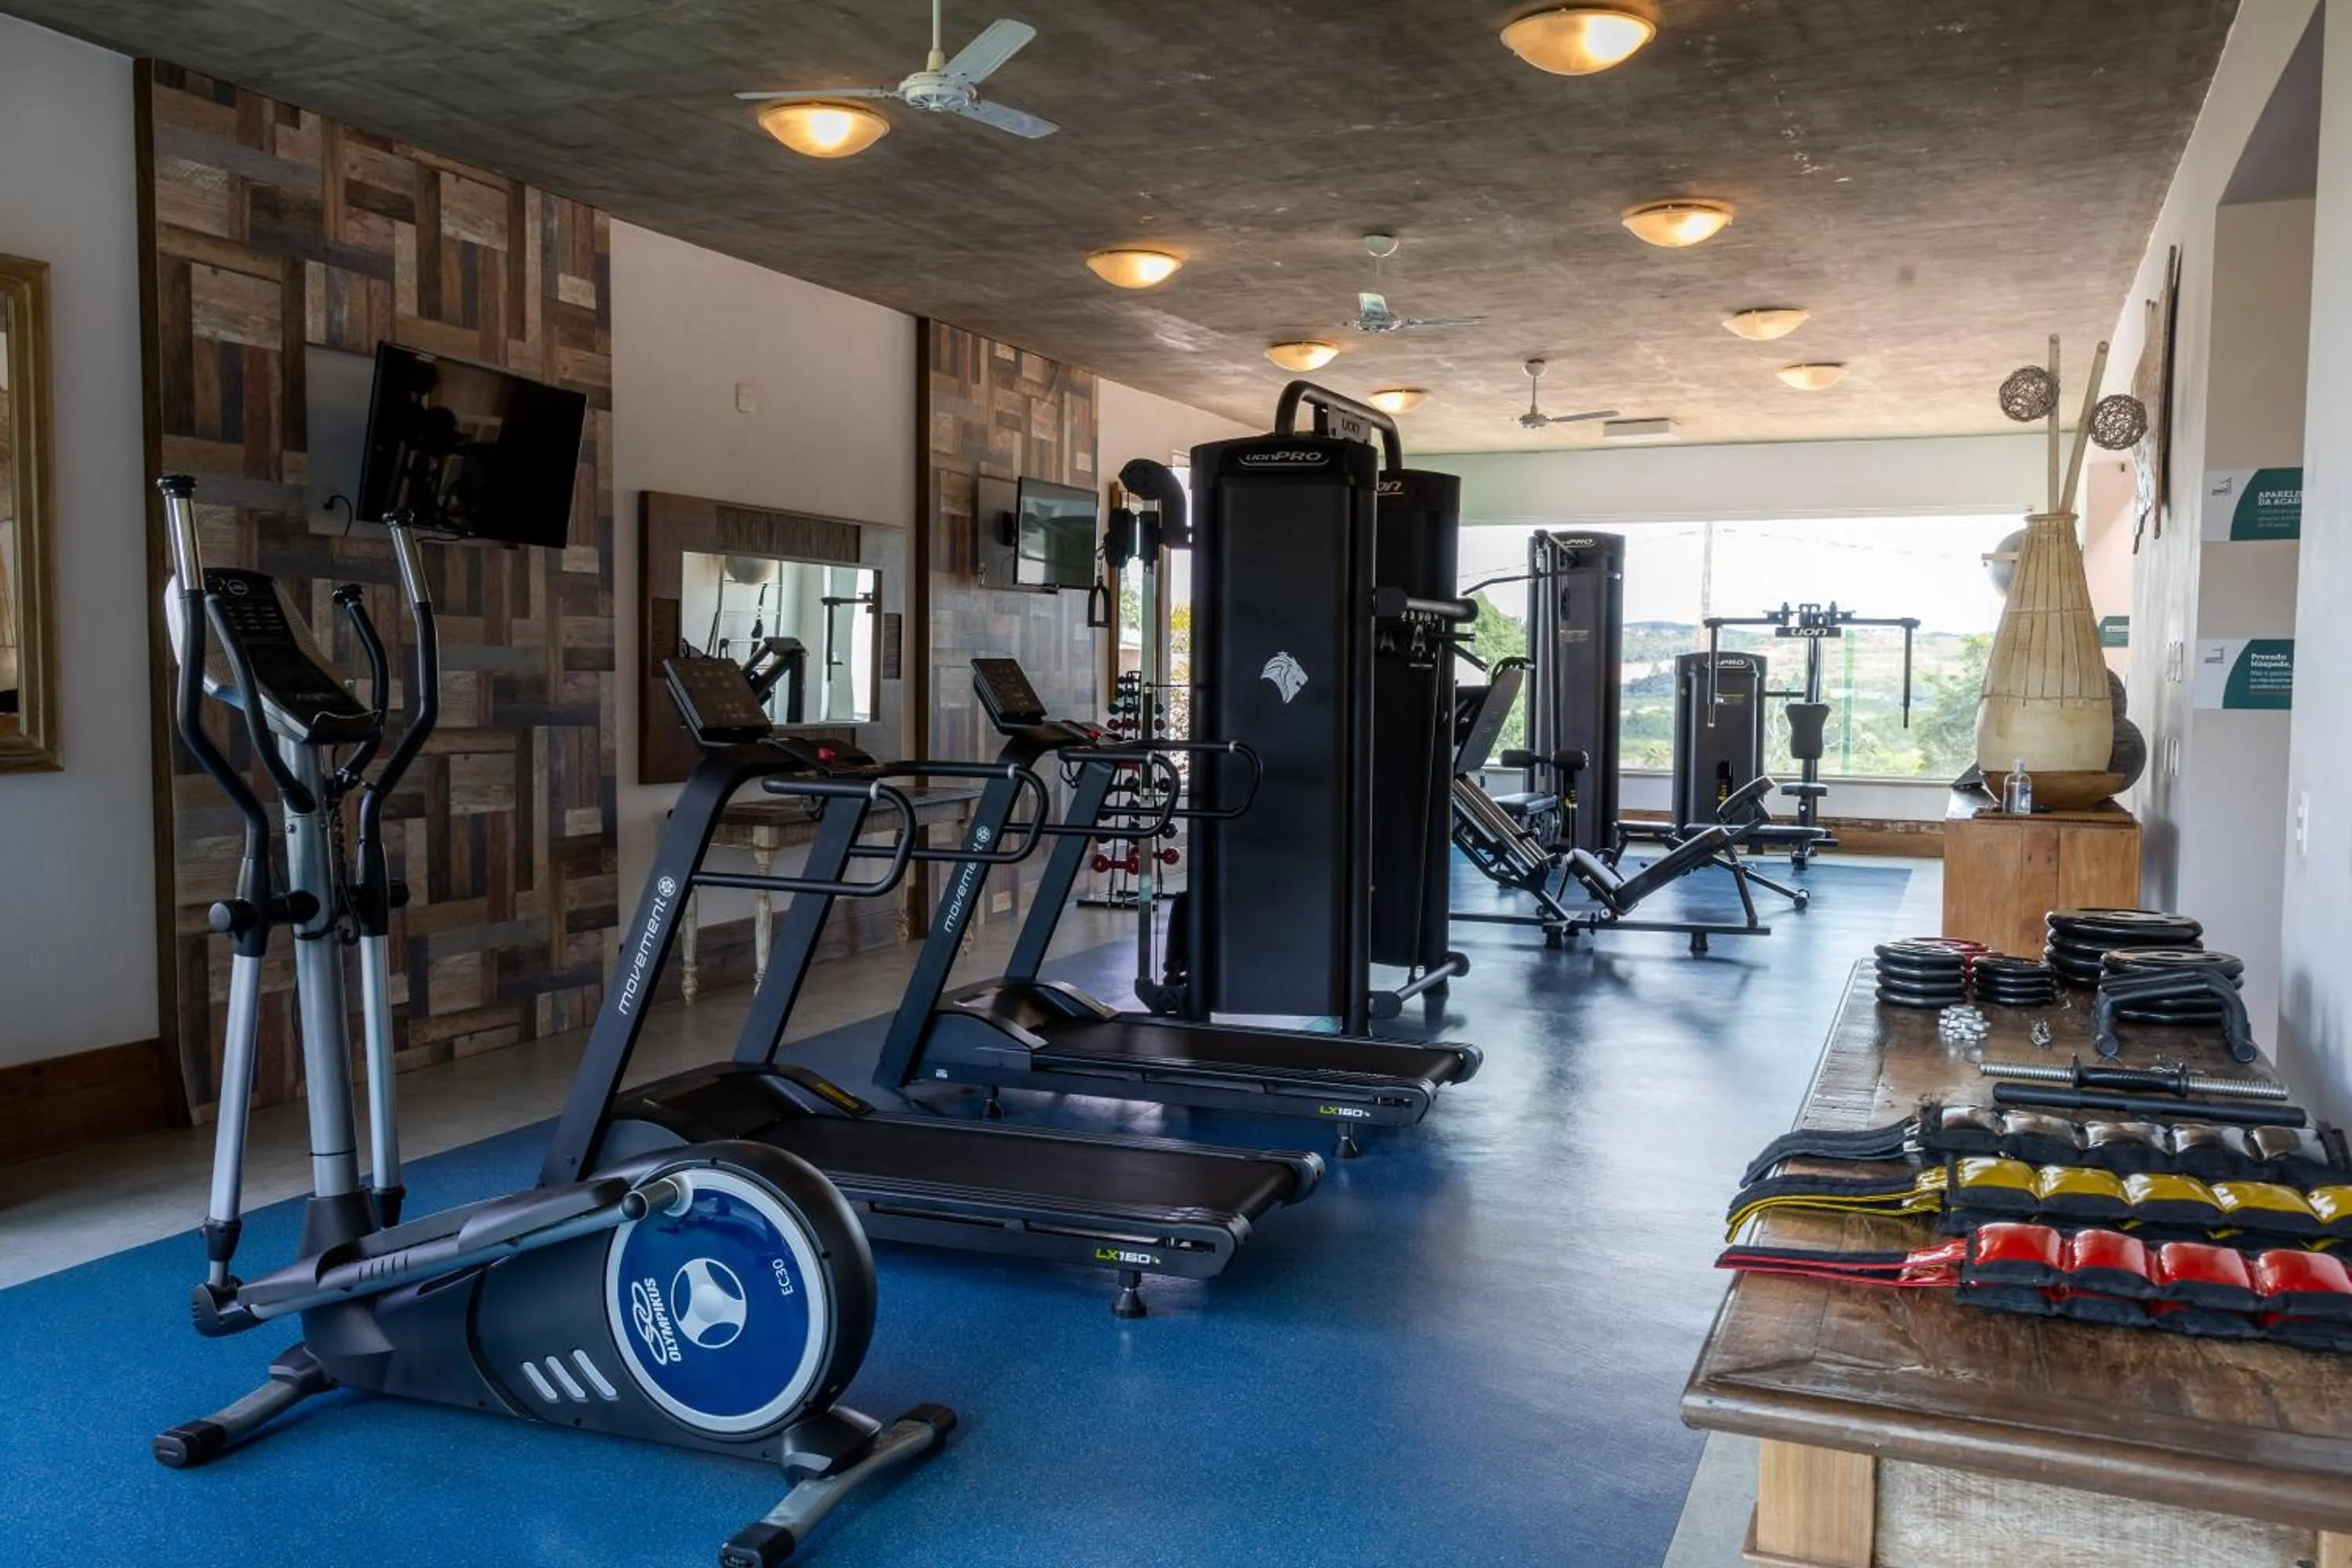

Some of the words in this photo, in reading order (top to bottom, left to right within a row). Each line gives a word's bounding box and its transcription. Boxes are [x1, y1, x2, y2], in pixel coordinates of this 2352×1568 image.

[944, 842, 984, 933] movemet
[619, 896, 667, 1016] movement
[644, 1277, 682, 1362] OLYMPIKUS
[772, 1258, 794, 1296] EC30
